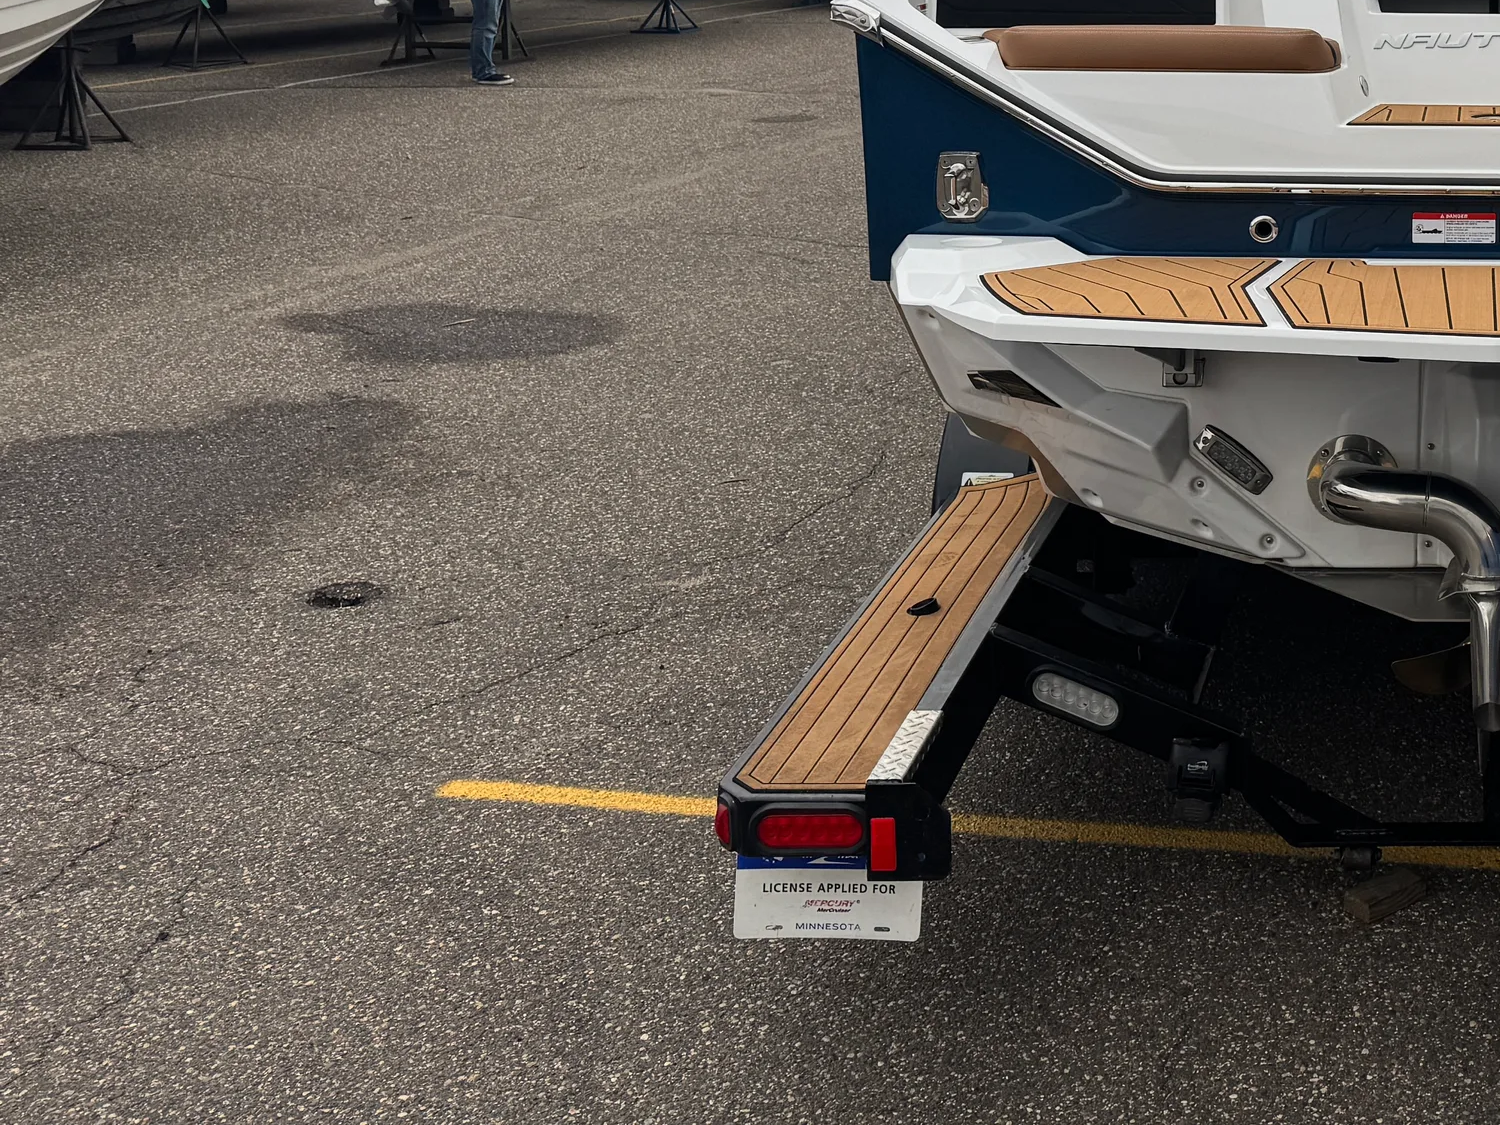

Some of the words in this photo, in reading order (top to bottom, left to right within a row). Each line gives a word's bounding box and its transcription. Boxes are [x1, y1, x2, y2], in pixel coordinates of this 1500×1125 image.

[762, 882, 813, 893] LICENSE
[817, 882, 868, 894] APPLIED
[872, 883, 896, 894] FOR
[795, 922, 862, 931] MINNESOTA
